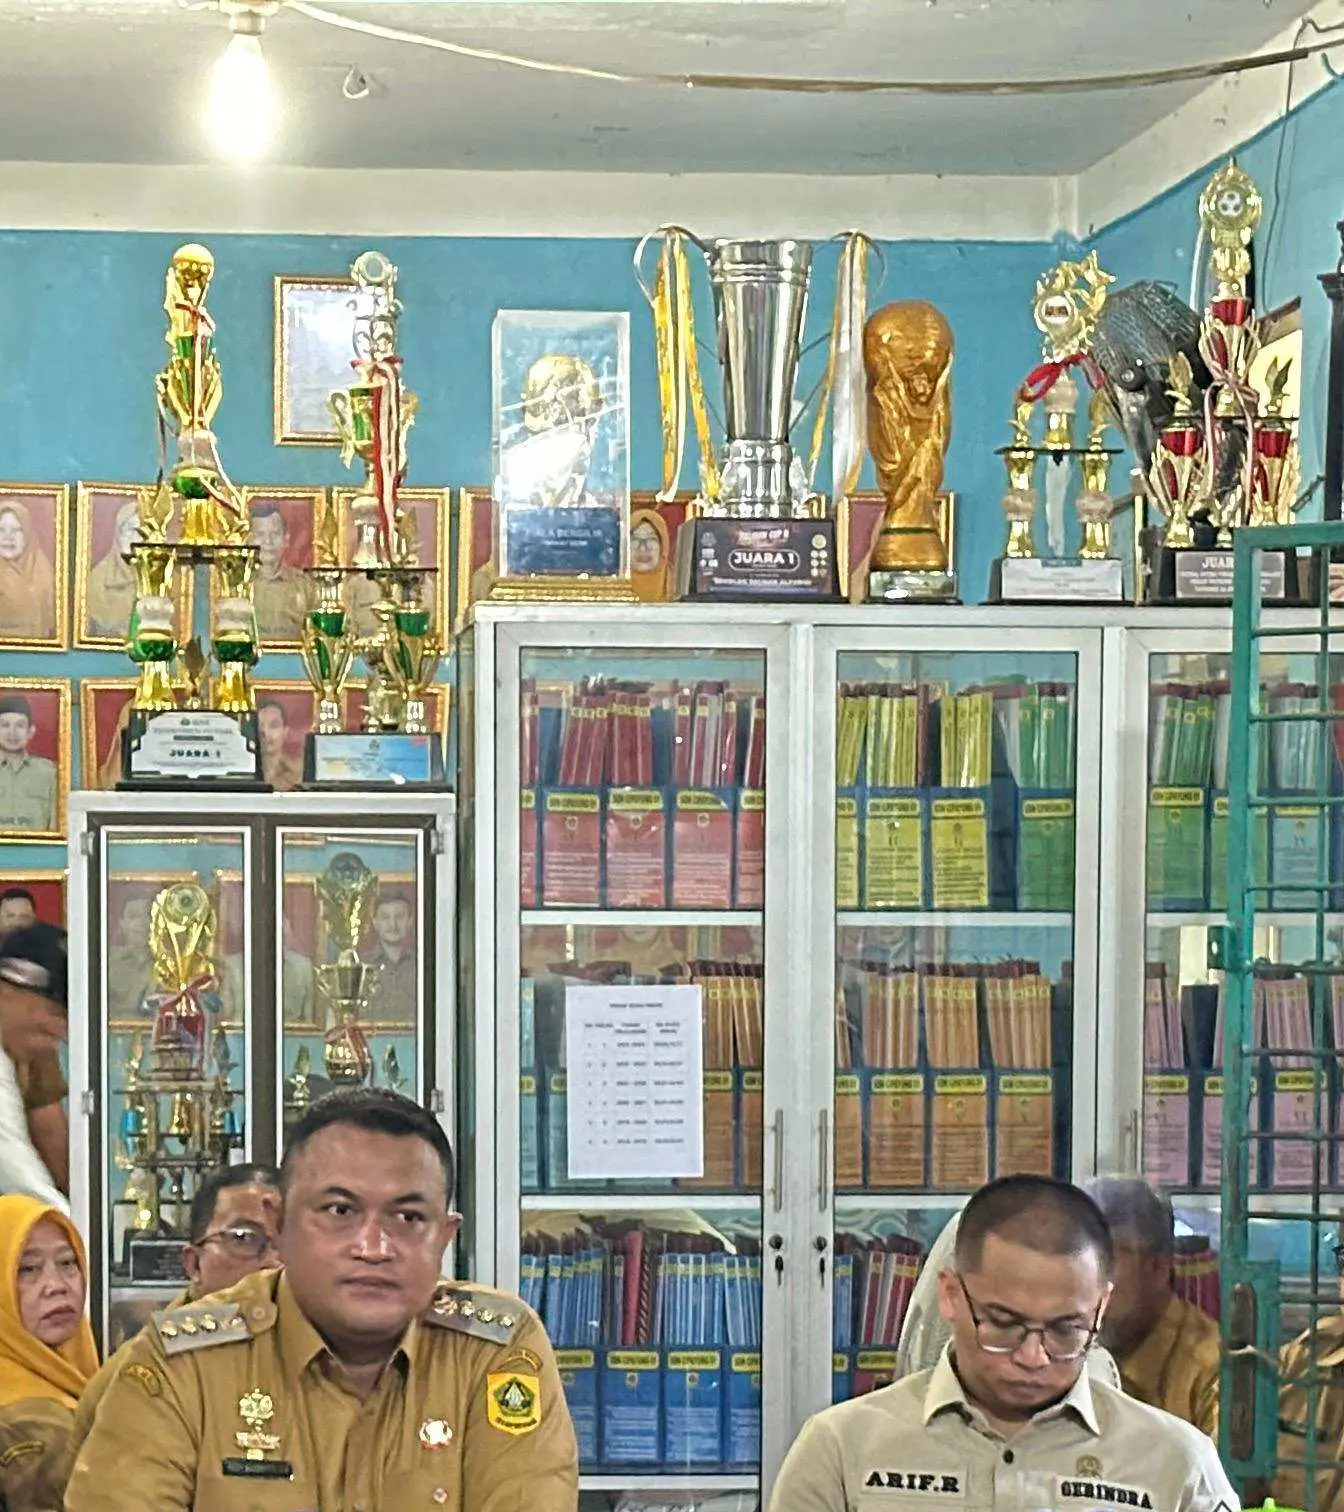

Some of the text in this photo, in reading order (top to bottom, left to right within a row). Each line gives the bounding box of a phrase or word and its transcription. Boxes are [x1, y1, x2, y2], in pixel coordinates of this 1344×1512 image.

[733, 552, 795, 565] JUARA 1
[169, 749, 209, 757] JUARA
[866, 1470, 959, 1493] ARIF.R
[1061, 1480, 1153, 1510] GERINDRA
